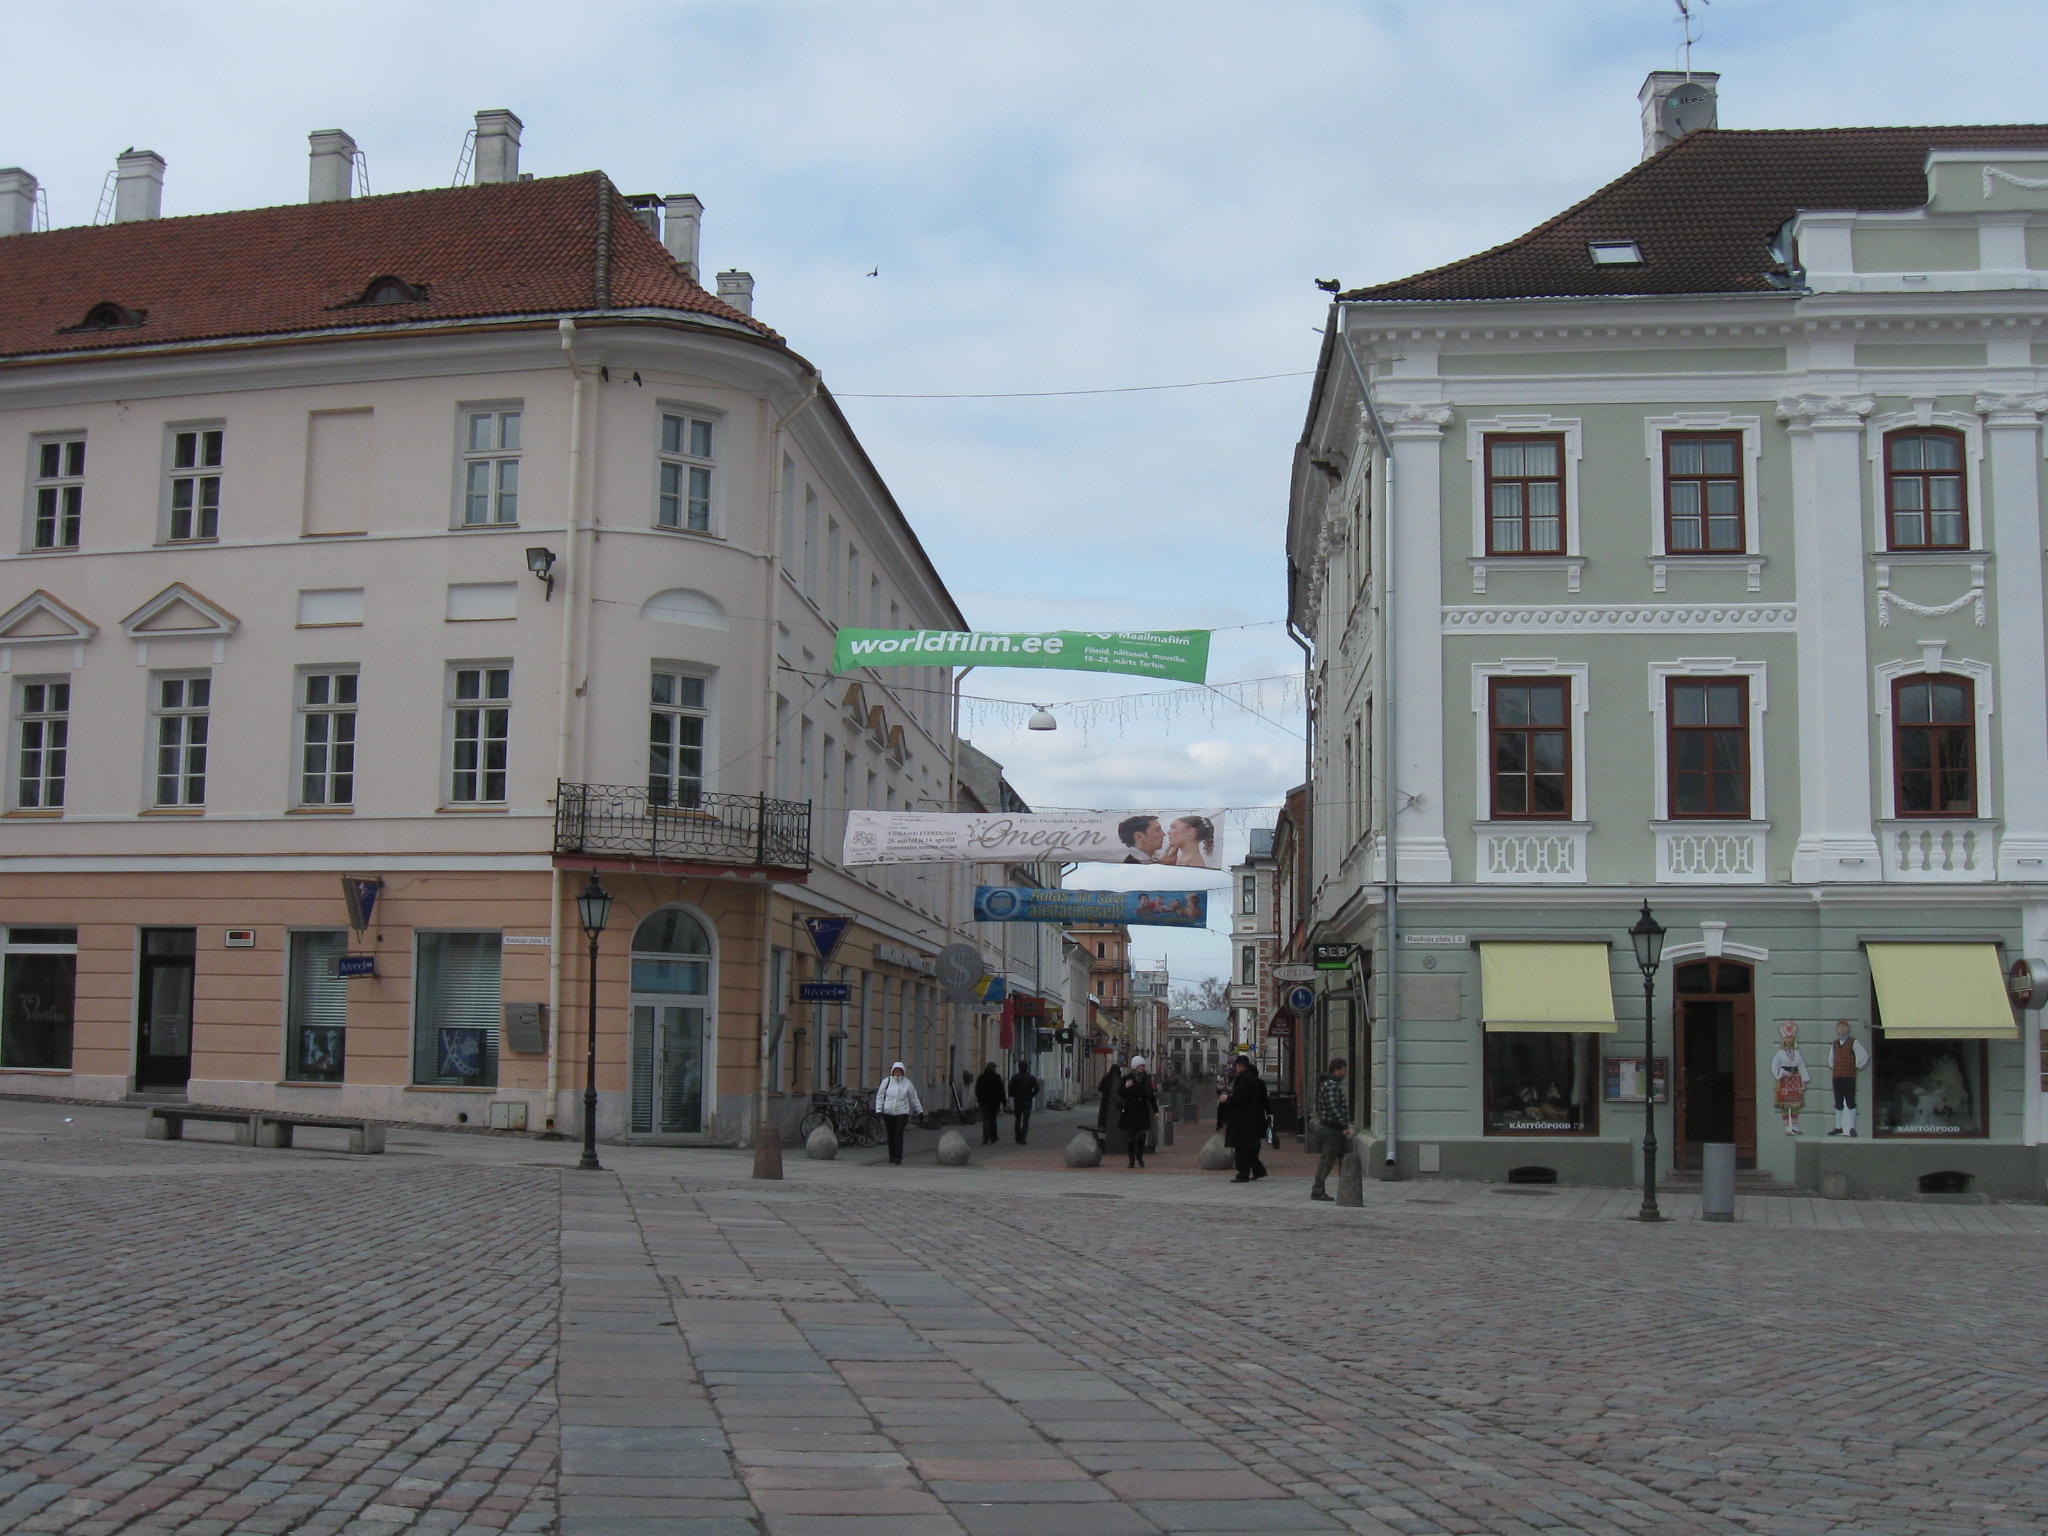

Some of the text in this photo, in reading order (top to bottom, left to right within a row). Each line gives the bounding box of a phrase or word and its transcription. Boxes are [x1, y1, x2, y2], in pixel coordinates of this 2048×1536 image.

[850, 631, 1064, 655] worldfilm.ee
[1118, 632, 1190, 646] Maailmafilm
[1084, 646, 1188, 664] Filmid, näitused, muusika.
[1113, 658, 1137, 666] märts
[1139, 660, 1167, 669] Tartus.
[979, 819, 1107, 862] Onegin
[1318, 947, 1348, 958] SEB
[341, 961, 366, 971] Juveel
[1278, 968, 1318, 978] OPTIKA
[802, 987, 837, 997] Juveel
